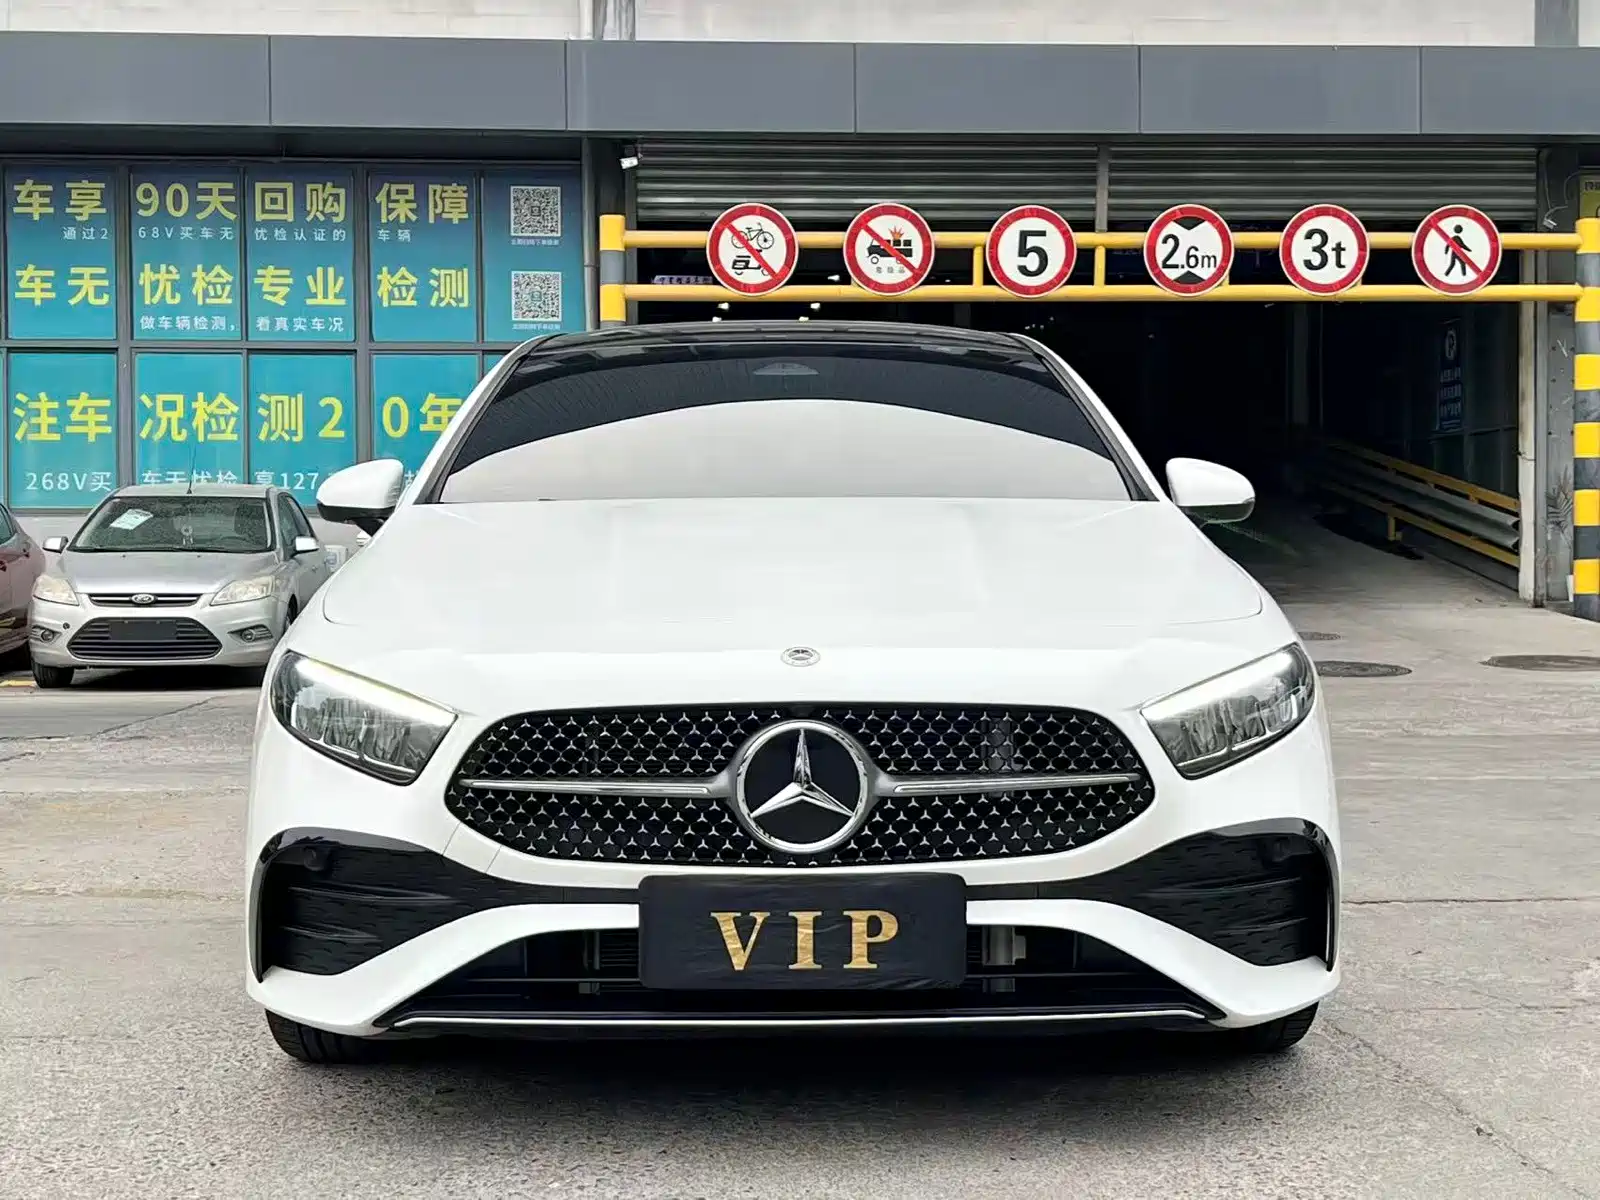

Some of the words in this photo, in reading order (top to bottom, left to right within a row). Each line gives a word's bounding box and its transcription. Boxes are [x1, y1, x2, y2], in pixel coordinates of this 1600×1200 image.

[13, 180, 107, 220] 车享
[136, 182, 238, 220] 90天
[255, 182, 346, 223] 回购
[375, 183, 469, 224] 保障
[1016, 230, 1049, 277] 5
[1161, 234, 1217, 269] 2.6m
[1303, 228, 1346, 271] 3t
[15, 264, 110, 306] 车无
[138, 263, 233, 305] 忧检
[254, 265, 347, 306] 专业
[377, 266, 469, 307] 检测
[13, 392, 112, 442] 注车
[139, 392, 239, 442] 况检
[258, 393, 345, 442] 测2
[26, 471, 112, 492] 268V买
[710, 910, 899, 971] VIP
